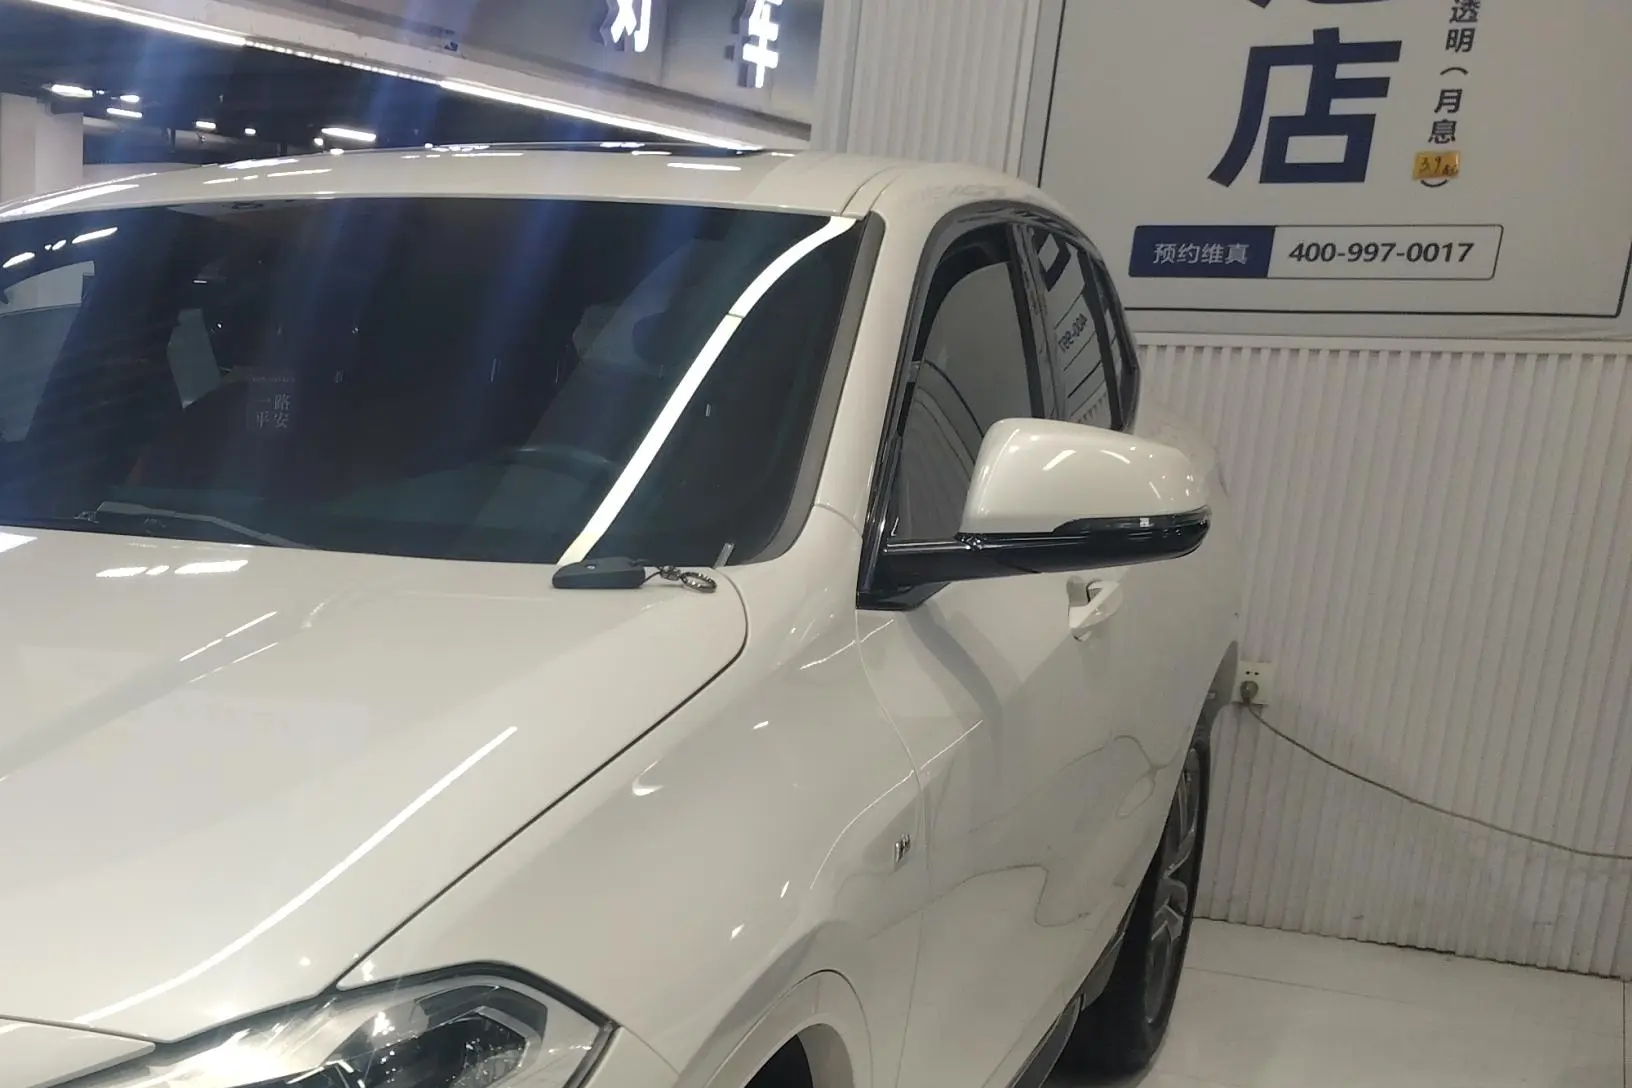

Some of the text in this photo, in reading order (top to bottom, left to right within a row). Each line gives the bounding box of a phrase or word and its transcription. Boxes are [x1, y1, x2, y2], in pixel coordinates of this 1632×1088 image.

[1208, 0, 1402, 187] 店
[1153, 242, 1250, 264] 预约维真
[1289, 242, 1474, 263] 400-997-0017
